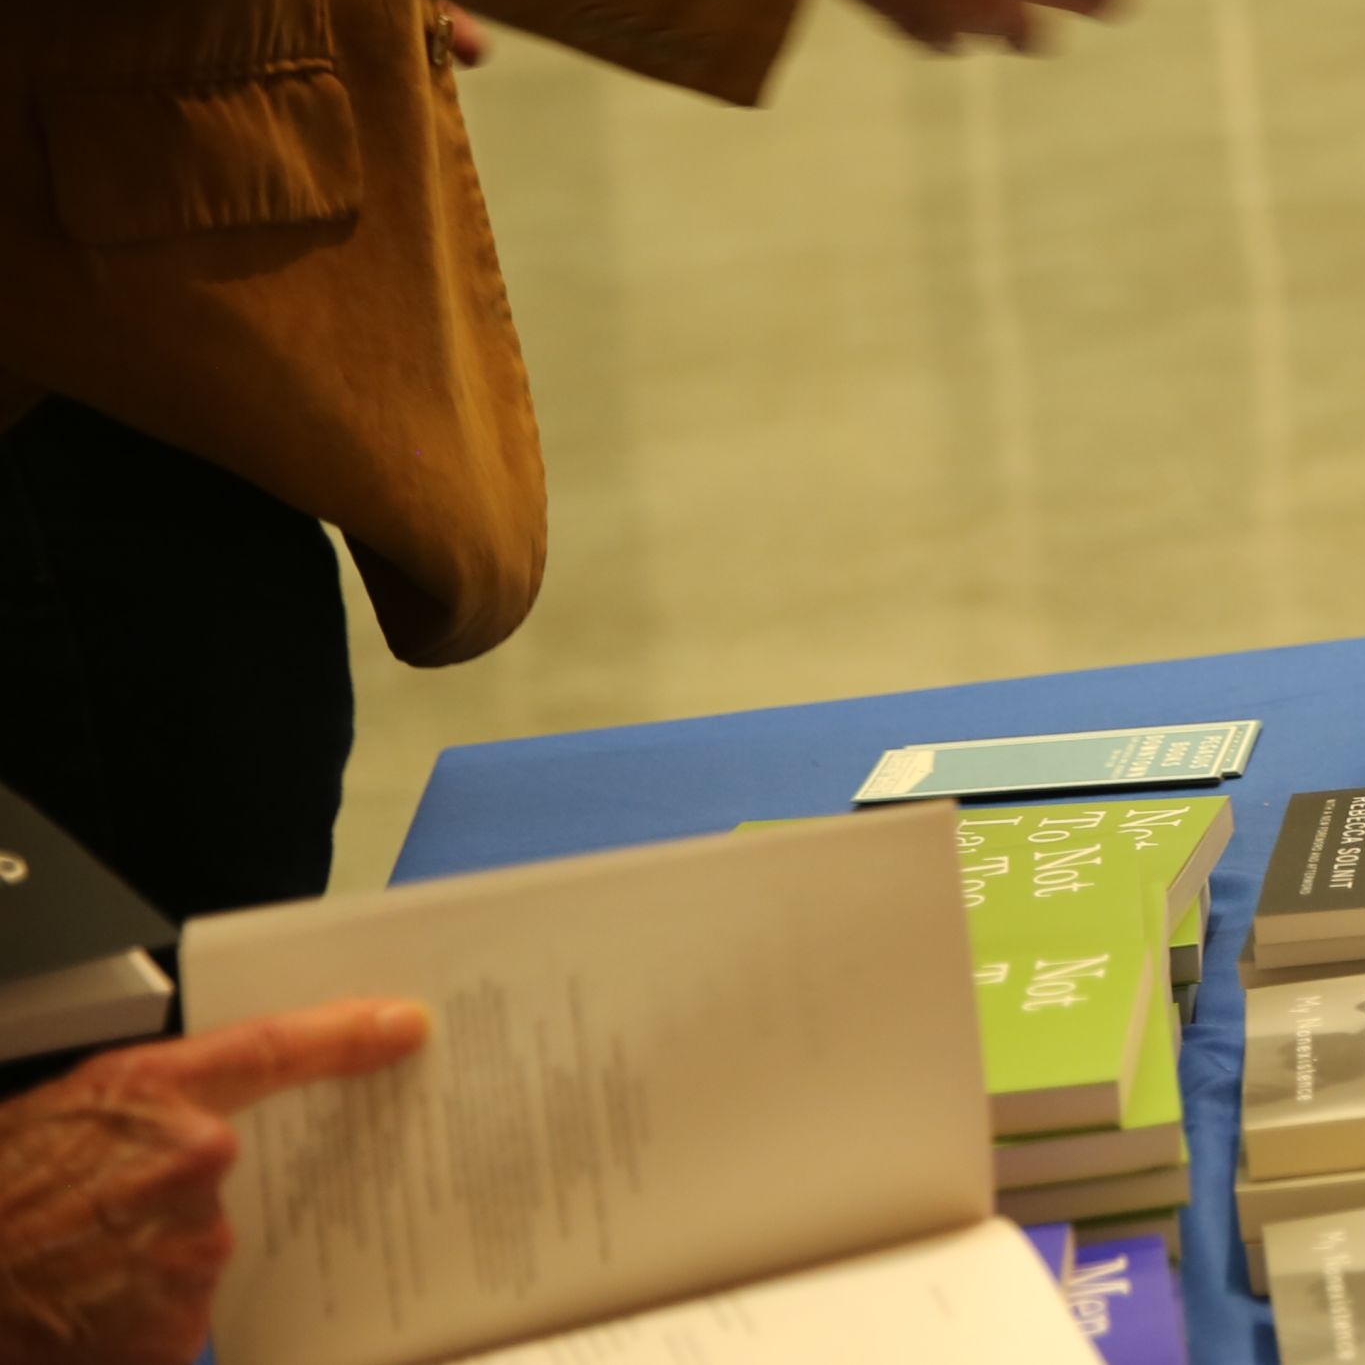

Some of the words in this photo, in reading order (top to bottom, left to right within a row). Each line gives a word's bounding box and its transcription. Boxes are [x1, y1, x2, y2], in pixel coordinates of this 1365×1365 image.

[1033, 843, 1102, 898] Not
[1328, 847, 1362, 889] SOLNIT
[1021, 954, 1111, 1012] Not
[1287, 995, 1322, 1013] My
[1295, 1017, 1322, 1101] Nonexistence
